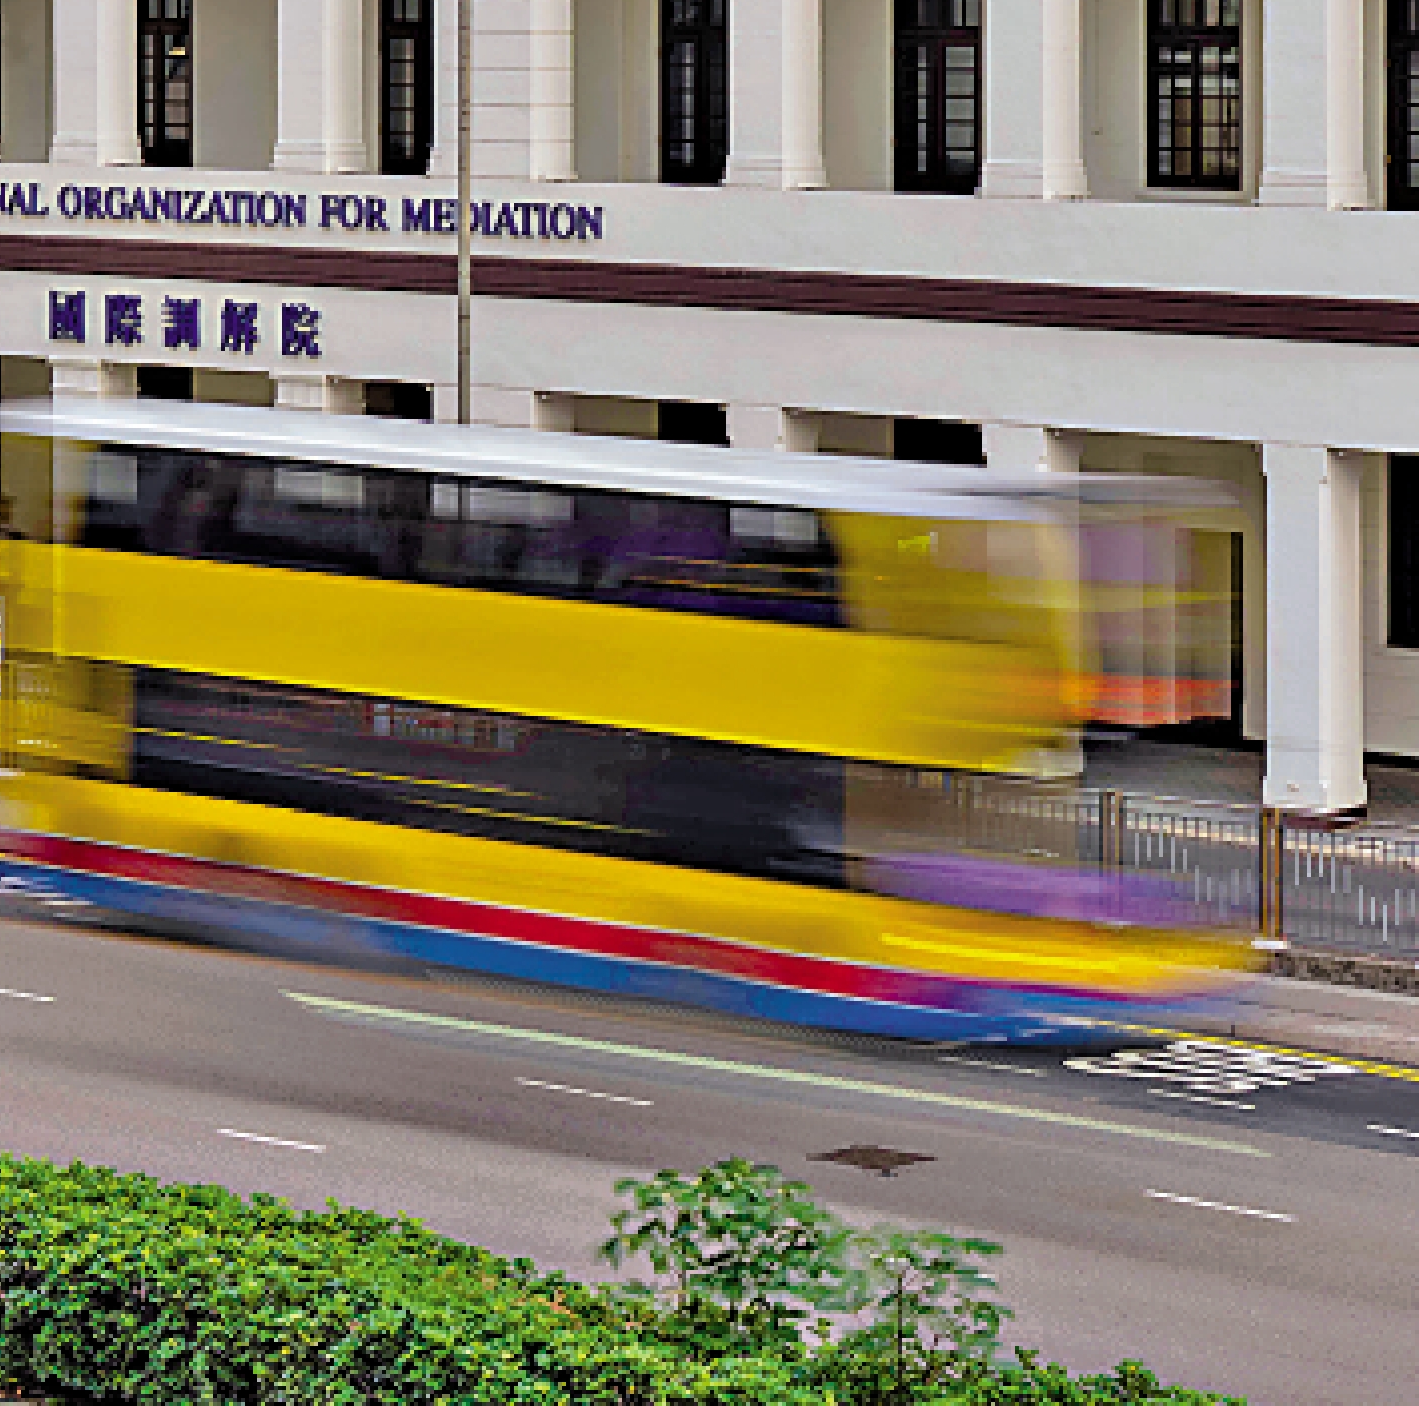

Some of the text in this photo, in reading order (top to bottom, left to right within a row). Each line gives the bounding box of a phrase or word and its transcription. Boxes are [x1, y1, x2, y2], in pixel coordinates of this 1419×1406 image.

[57, 184, 307, 227] ORGANIZATION
[319, 194, 390, 232] FOR
[48, 290, 323, 360] 國際調解院
